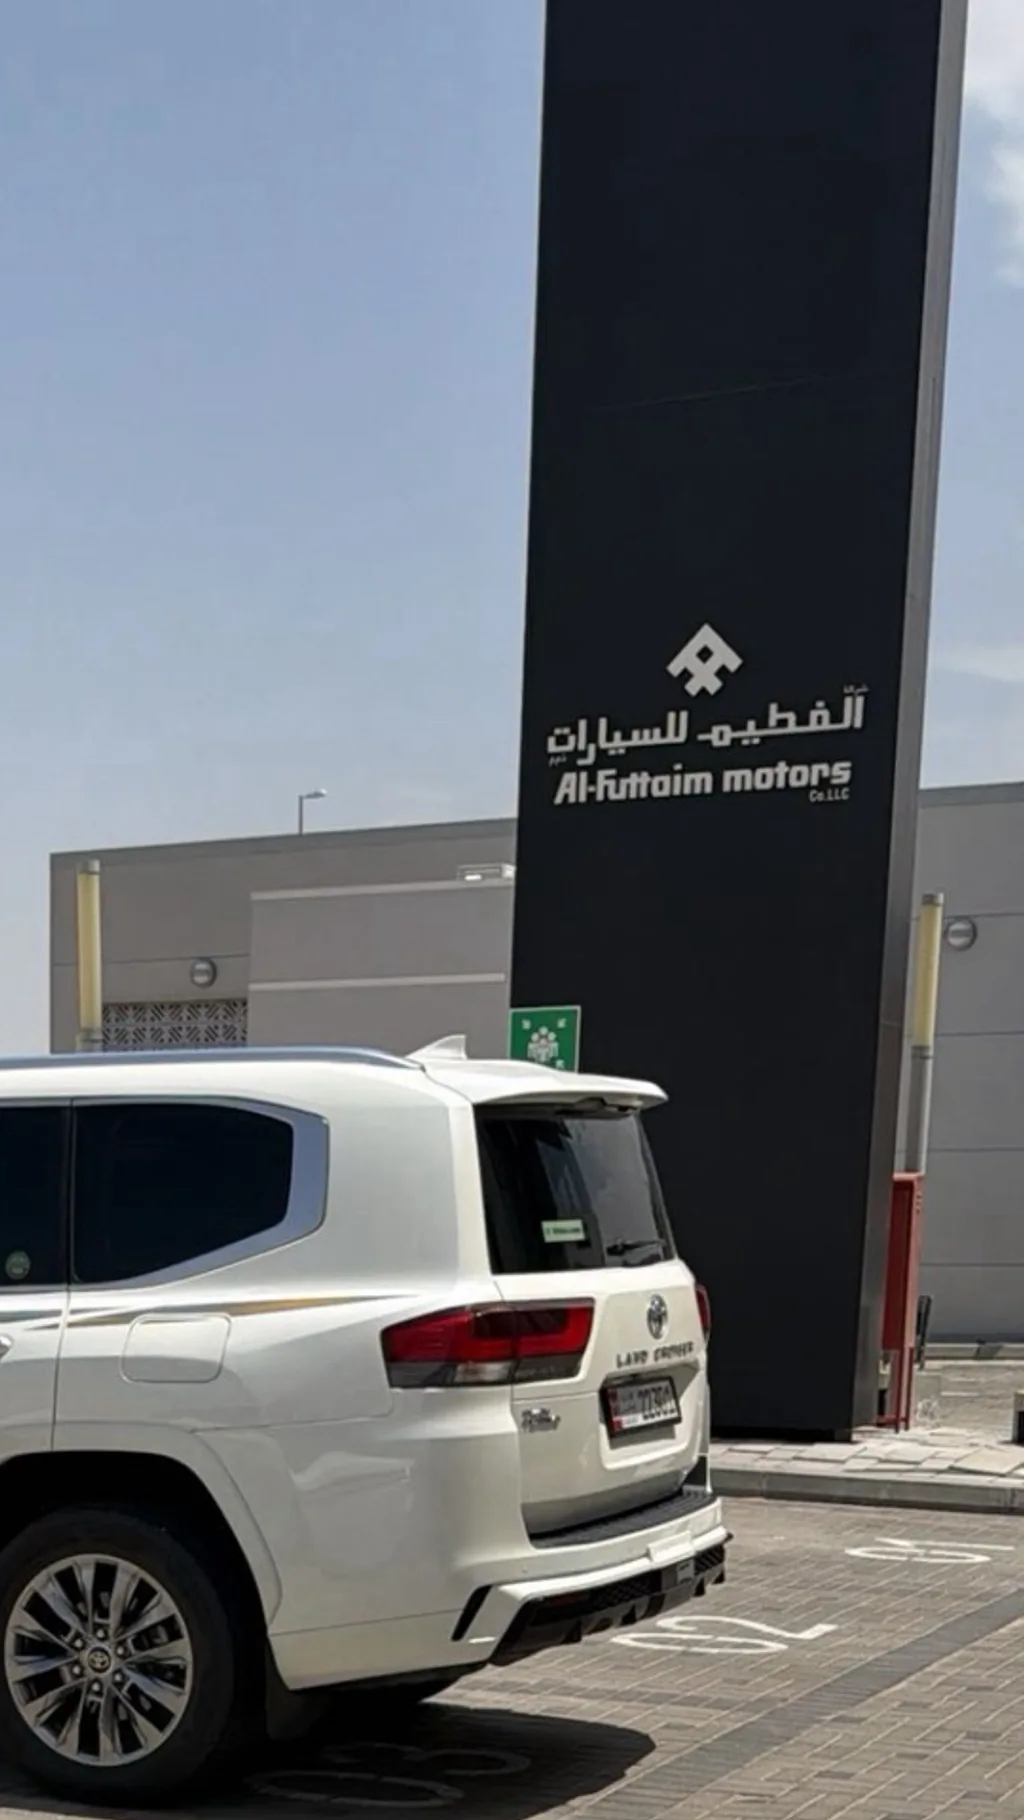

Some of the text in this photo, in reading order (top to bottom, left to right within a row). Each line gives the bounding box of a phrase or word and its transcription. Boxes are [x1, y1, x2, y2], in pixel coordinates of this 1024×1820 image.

[547, 696, 864, 766] الفطيم للسيارات
[554, 760, 852, 805] Al-Futtaim motors
[610, 1615, 839, 1654] 02
